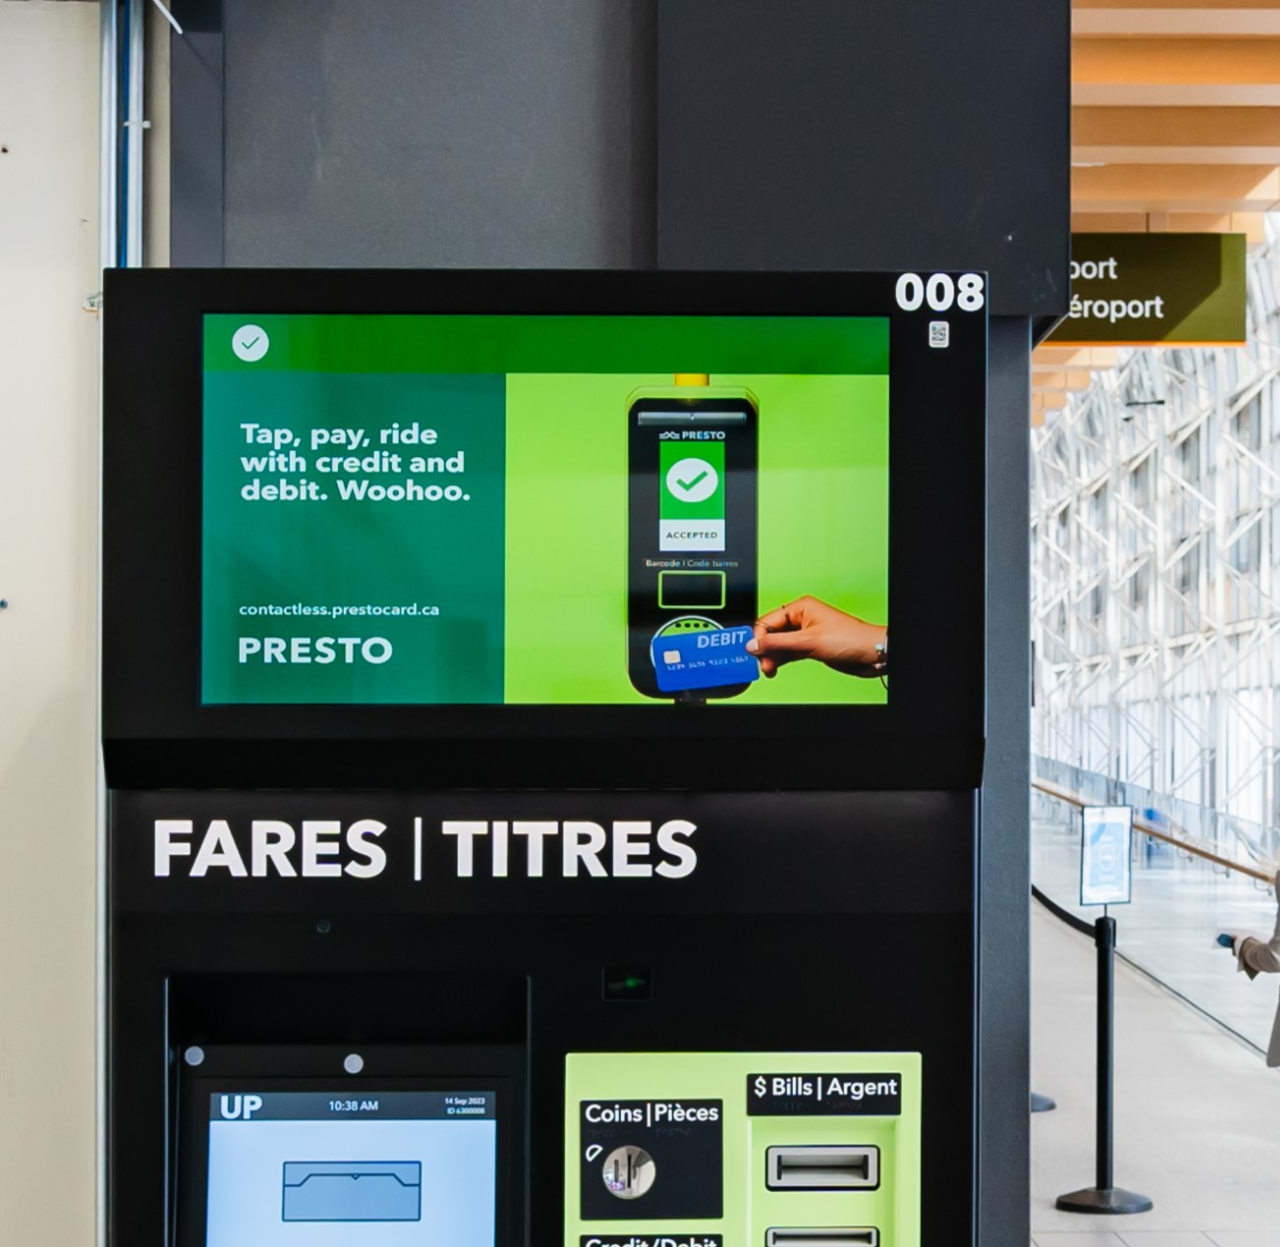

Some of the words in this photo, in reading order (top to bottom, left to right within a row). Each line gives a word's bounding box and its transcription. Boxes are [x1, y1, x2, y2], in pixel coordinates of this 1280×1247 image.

[895, 273, 985, 312] 008
[240, 423, 301, 450] Tap,
[311, 428, 370, 450] pay,
[380, 422, 438, 444] ride
[682, 431, 726, 440] PRESTO
[240, 450, 306, 472] with
[316, 451, 402, 472] credit
[409, 451, 465, 472] and
[240, 479, 328, 500] debit.
[336, 479, 470, 501] Woohoo.
[239, 603, 440, 618] contactless.prestocard.ca
[697, 630, 747, 648] DEBIT
[238, 637, 393, 664] PRESTO
[153, 820, 387, 879] FARES
[442, 820, 698, 879] TITRES
[772, 1077, 813, 1096] Bills
[827, 1077, 898, 1100] Argent
[220, 1095, 263, 1119] UP
[329, 1101, 358, 1111] 10:38
[360, 1101, 379, 1111] AM
[585, 1104, 643, 1123] Coins
[654, 1103, 719, 1123] Pièces
